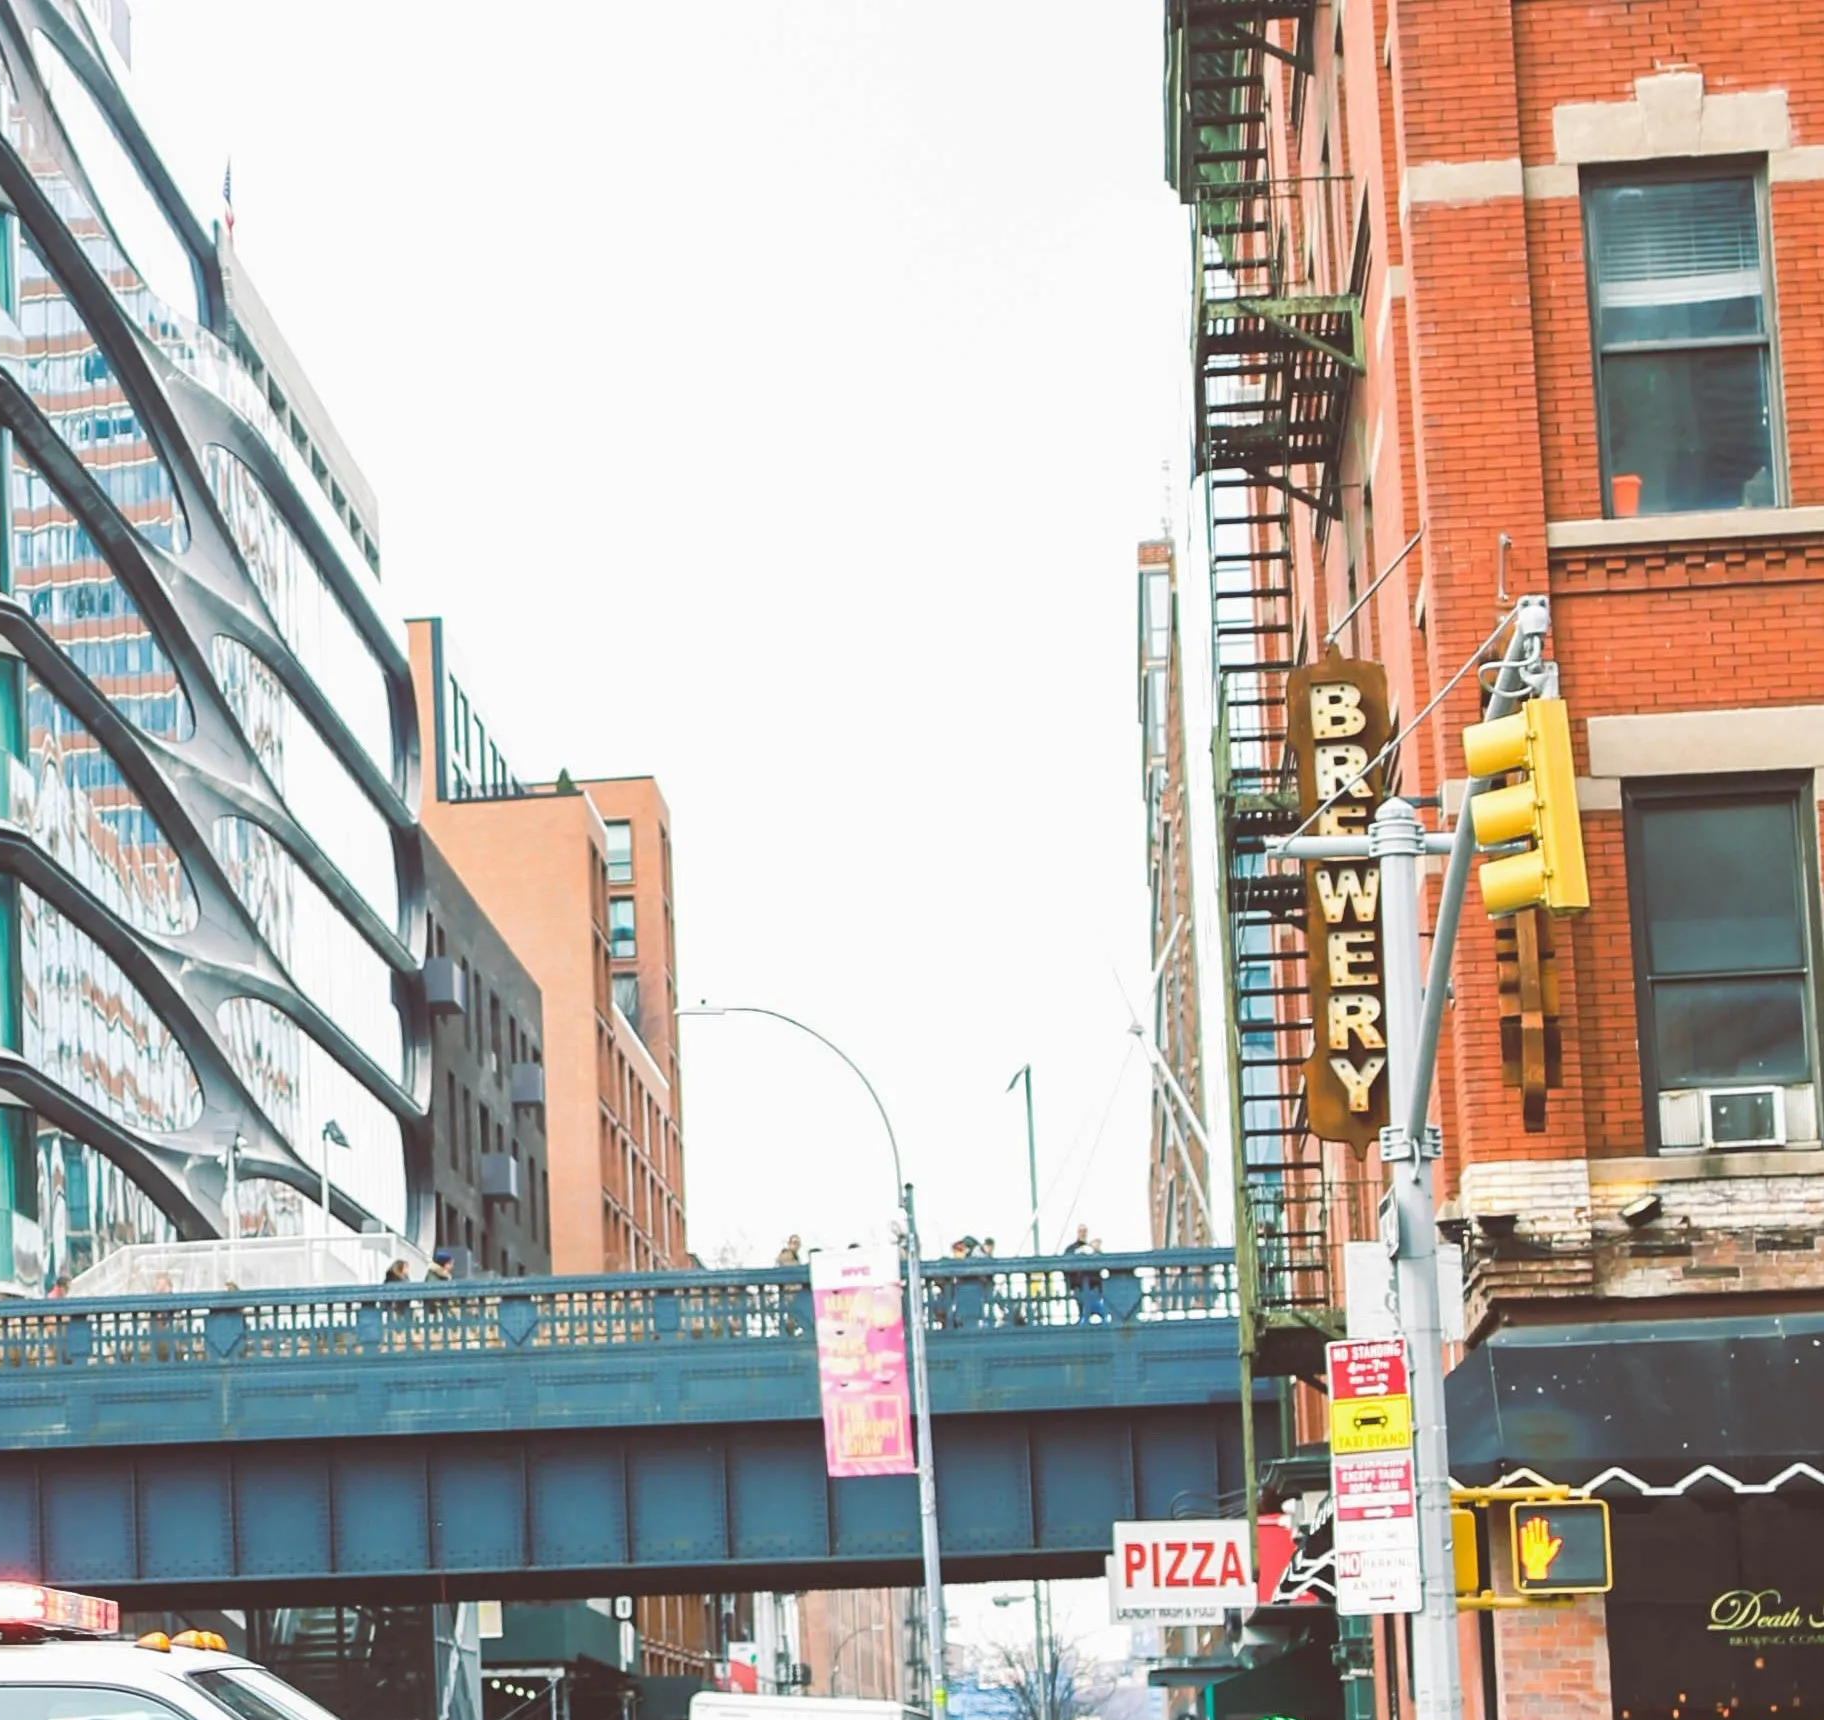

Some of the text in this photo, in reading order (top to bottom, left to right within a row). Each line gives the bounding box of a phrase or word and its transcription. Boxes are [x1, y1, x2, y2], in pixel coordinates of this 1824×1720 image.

[1309, 682, 1386, 1113] BREWERY
[1333, 1342, 1402, 1361] NO STANDING
[1338, 1432, 1406, 1449] TAXI STAND
[1124, 1541, 1246, 1588] PIZZA
[1339, 1553, 1360, 1575] NO
[1706, 1588, 1802, 1631] Death
